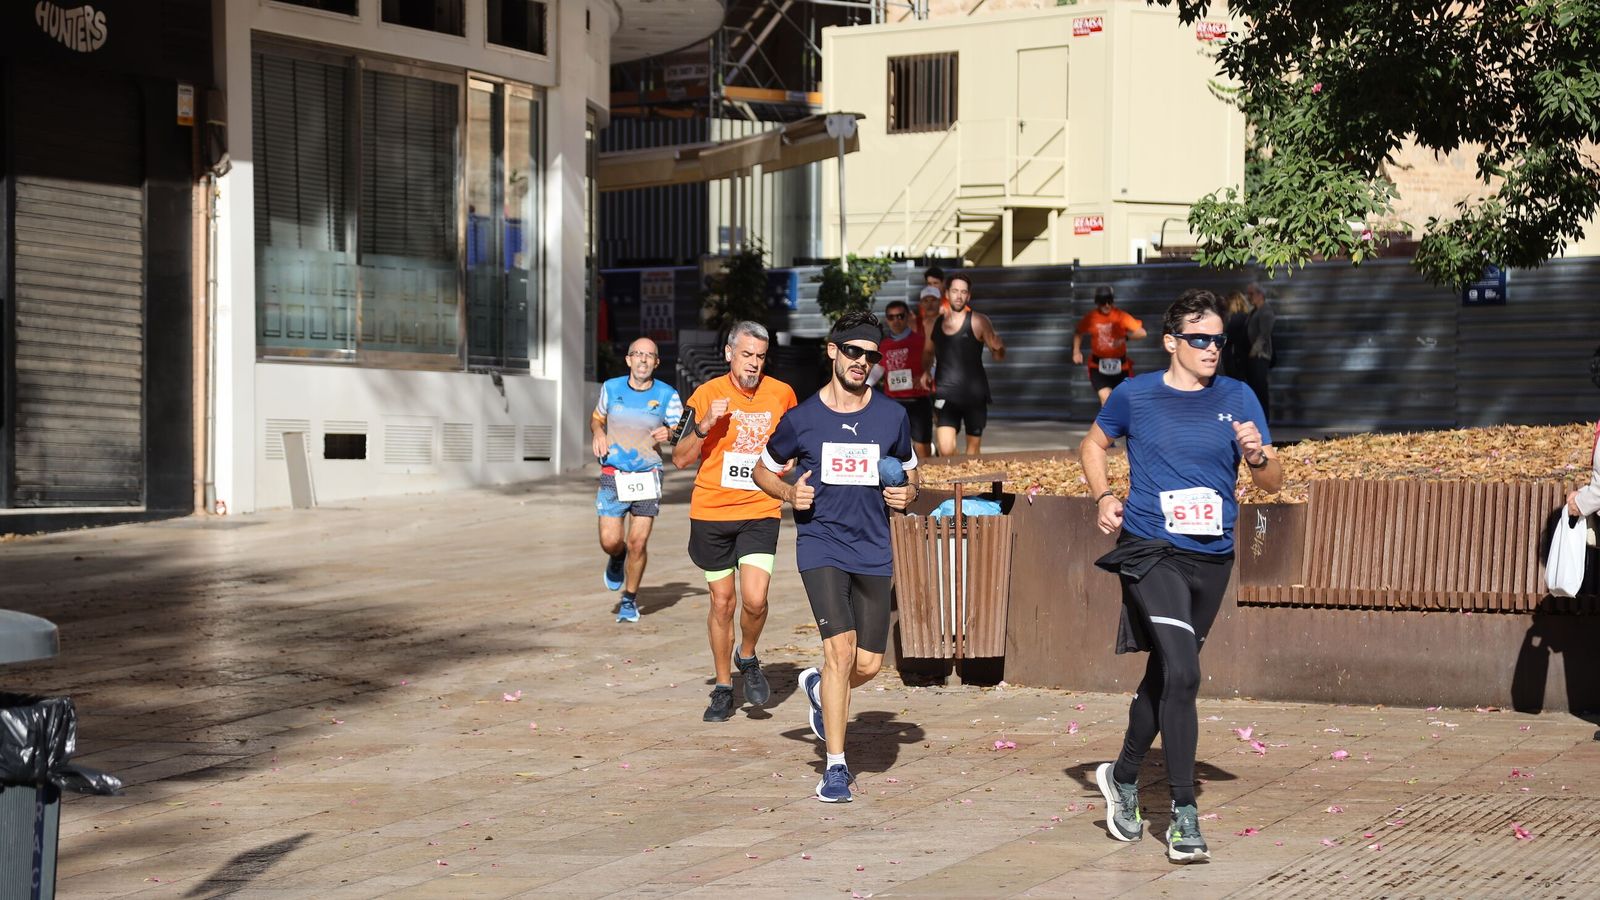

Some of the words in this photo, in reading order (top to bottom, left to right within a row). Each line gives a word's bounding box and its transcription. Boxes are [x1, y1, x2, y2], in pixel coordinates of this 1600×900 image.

[35, 1, 107, 52] HUNTERS
[832, 457, 868, 473] 531
[1173, 503, 1214, 520] 612
